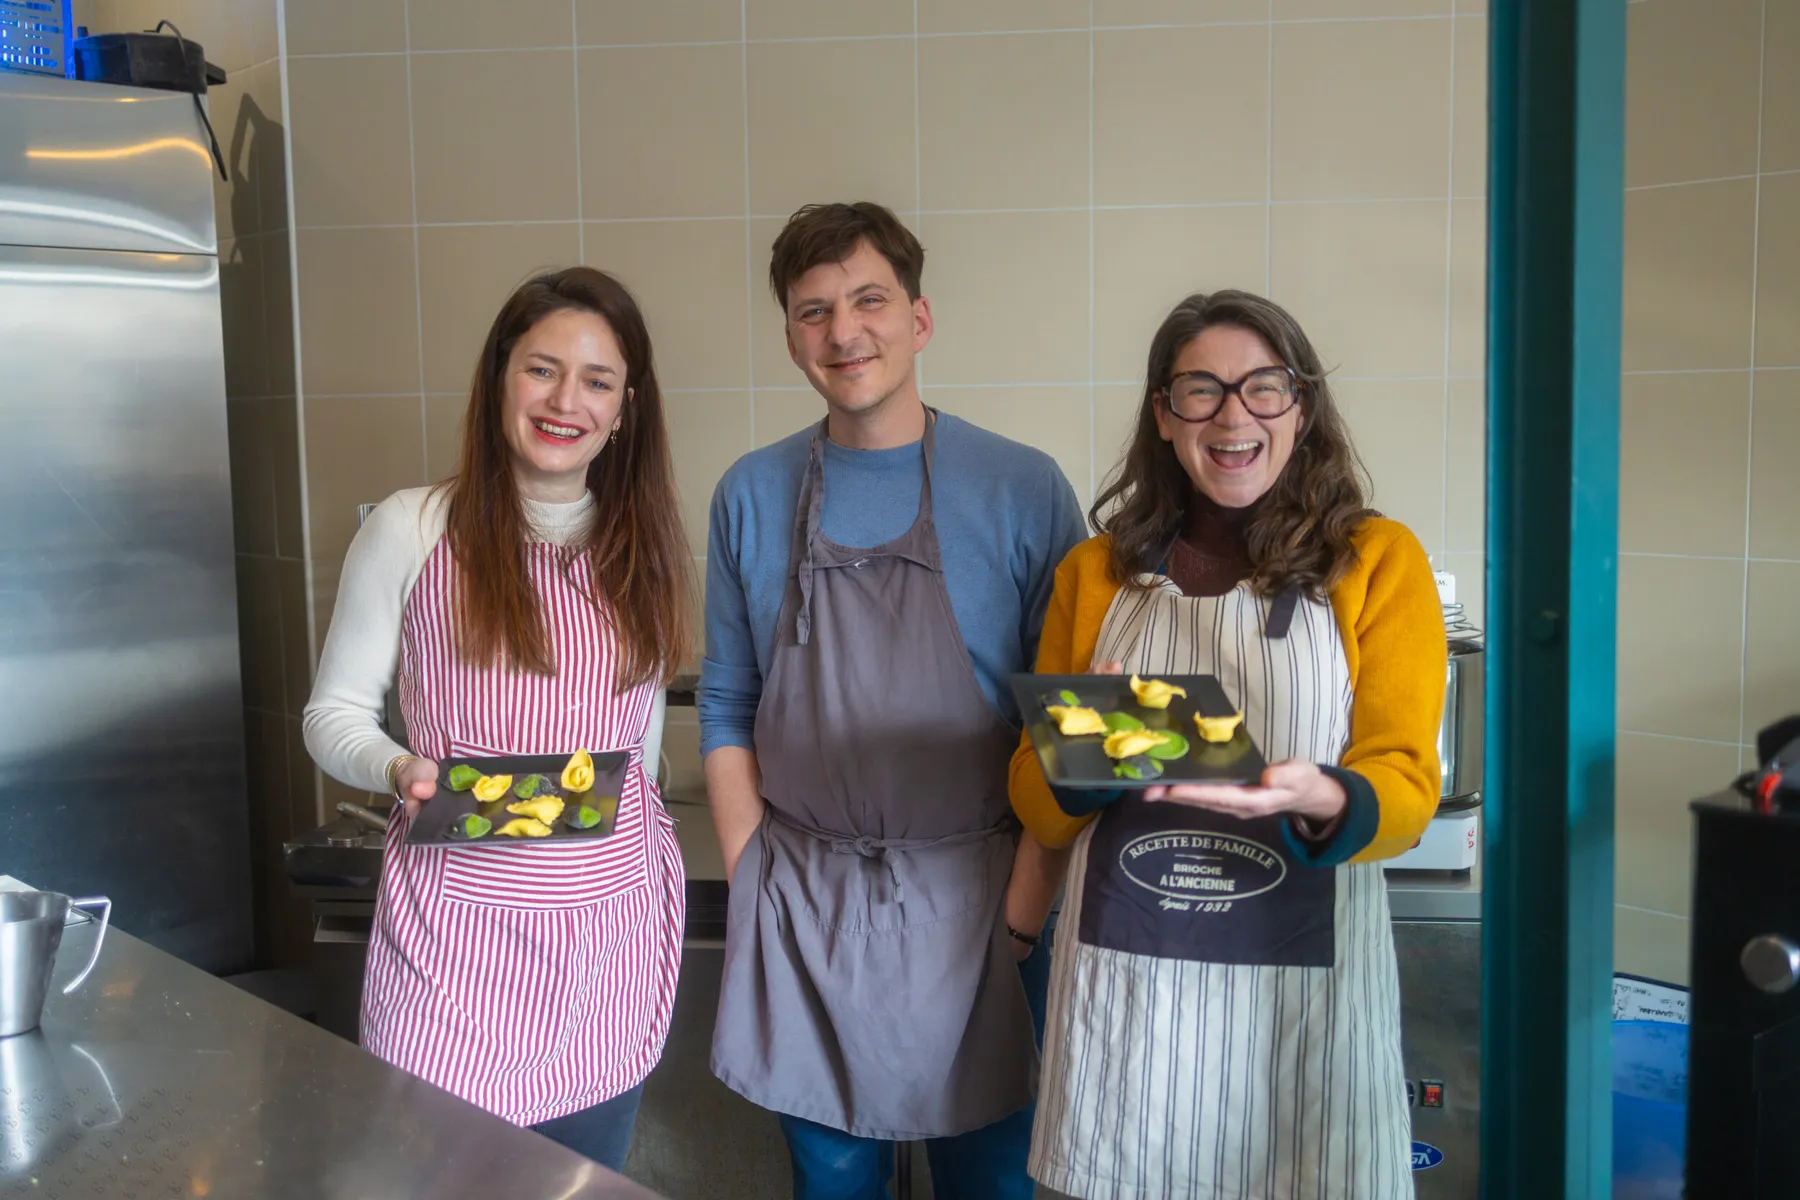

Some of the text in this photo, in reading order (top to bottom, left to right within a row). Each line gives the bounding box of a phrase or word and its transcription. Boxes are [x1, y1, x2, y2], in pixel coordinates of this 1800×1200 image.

[1128, 836, 1275, 869] RECETTE DE FAMILLE
[1173, 863, 1222, 875] BRIOCHE
[1159, 874, 1235, 892] A L'ANCIENNE
